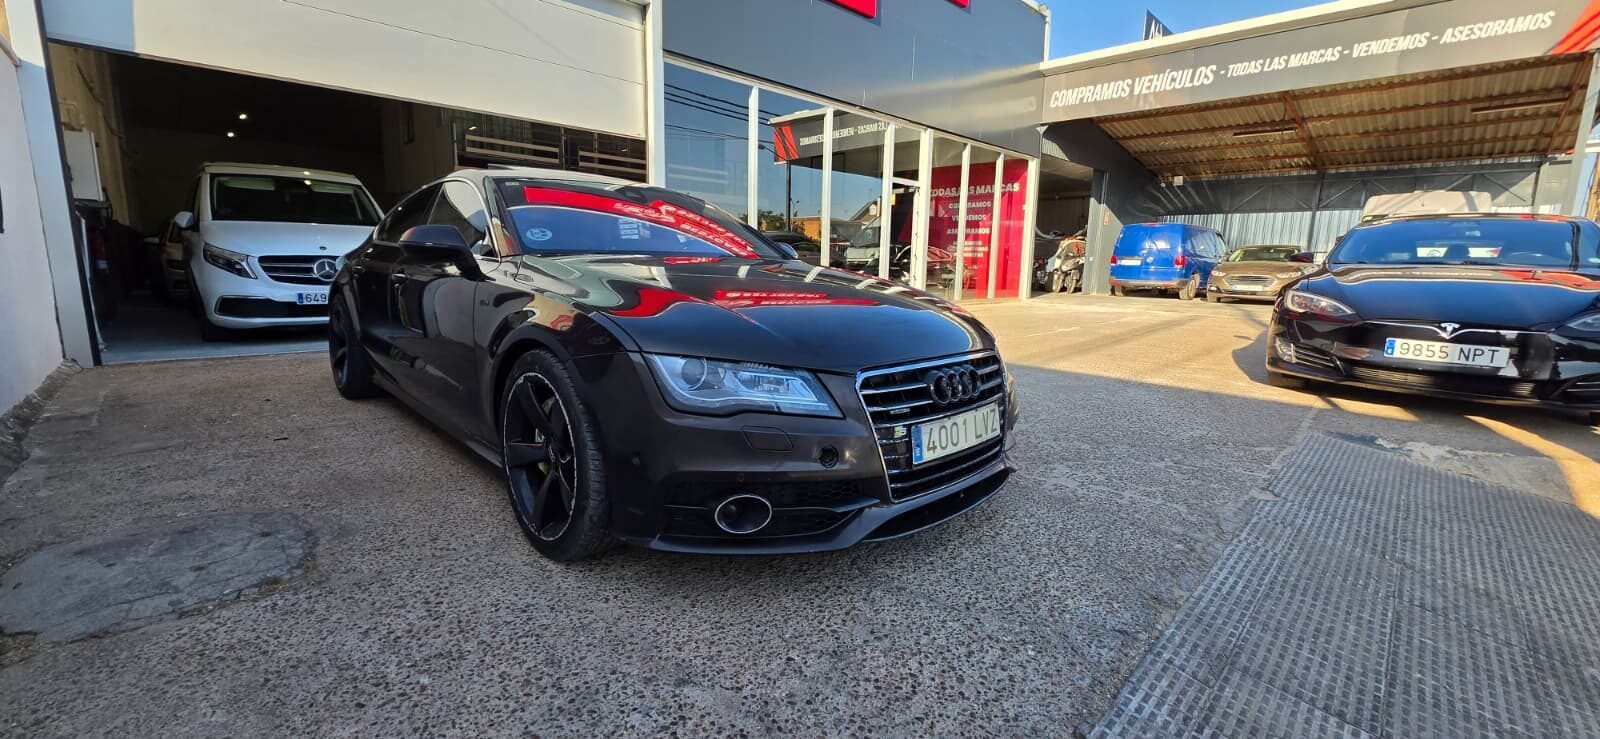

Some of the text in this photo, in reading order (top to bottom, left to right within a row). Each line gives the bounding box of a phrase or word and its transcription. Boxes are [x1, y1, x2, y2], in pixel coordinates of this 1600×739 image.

[1050, 79, 1132, 108] COMPRAMOS
[1133, 65, 1217, 96] VEHÍCULOS
[1227, 59, 1264, 78] TODAS
[1263, 55, 1288, 72] LAS
[1287, 46, 1343, 68] MARCAS
[1352, 31, 1430, 58] VENDEMOS
[1439, 11, 1556, 45] ASESORAMOS
[305, 293, 327, 303] 649
[1399, 342, 1500, 364] 9855 NPT
[926, 409, 997, 454] 4001 LVZ
